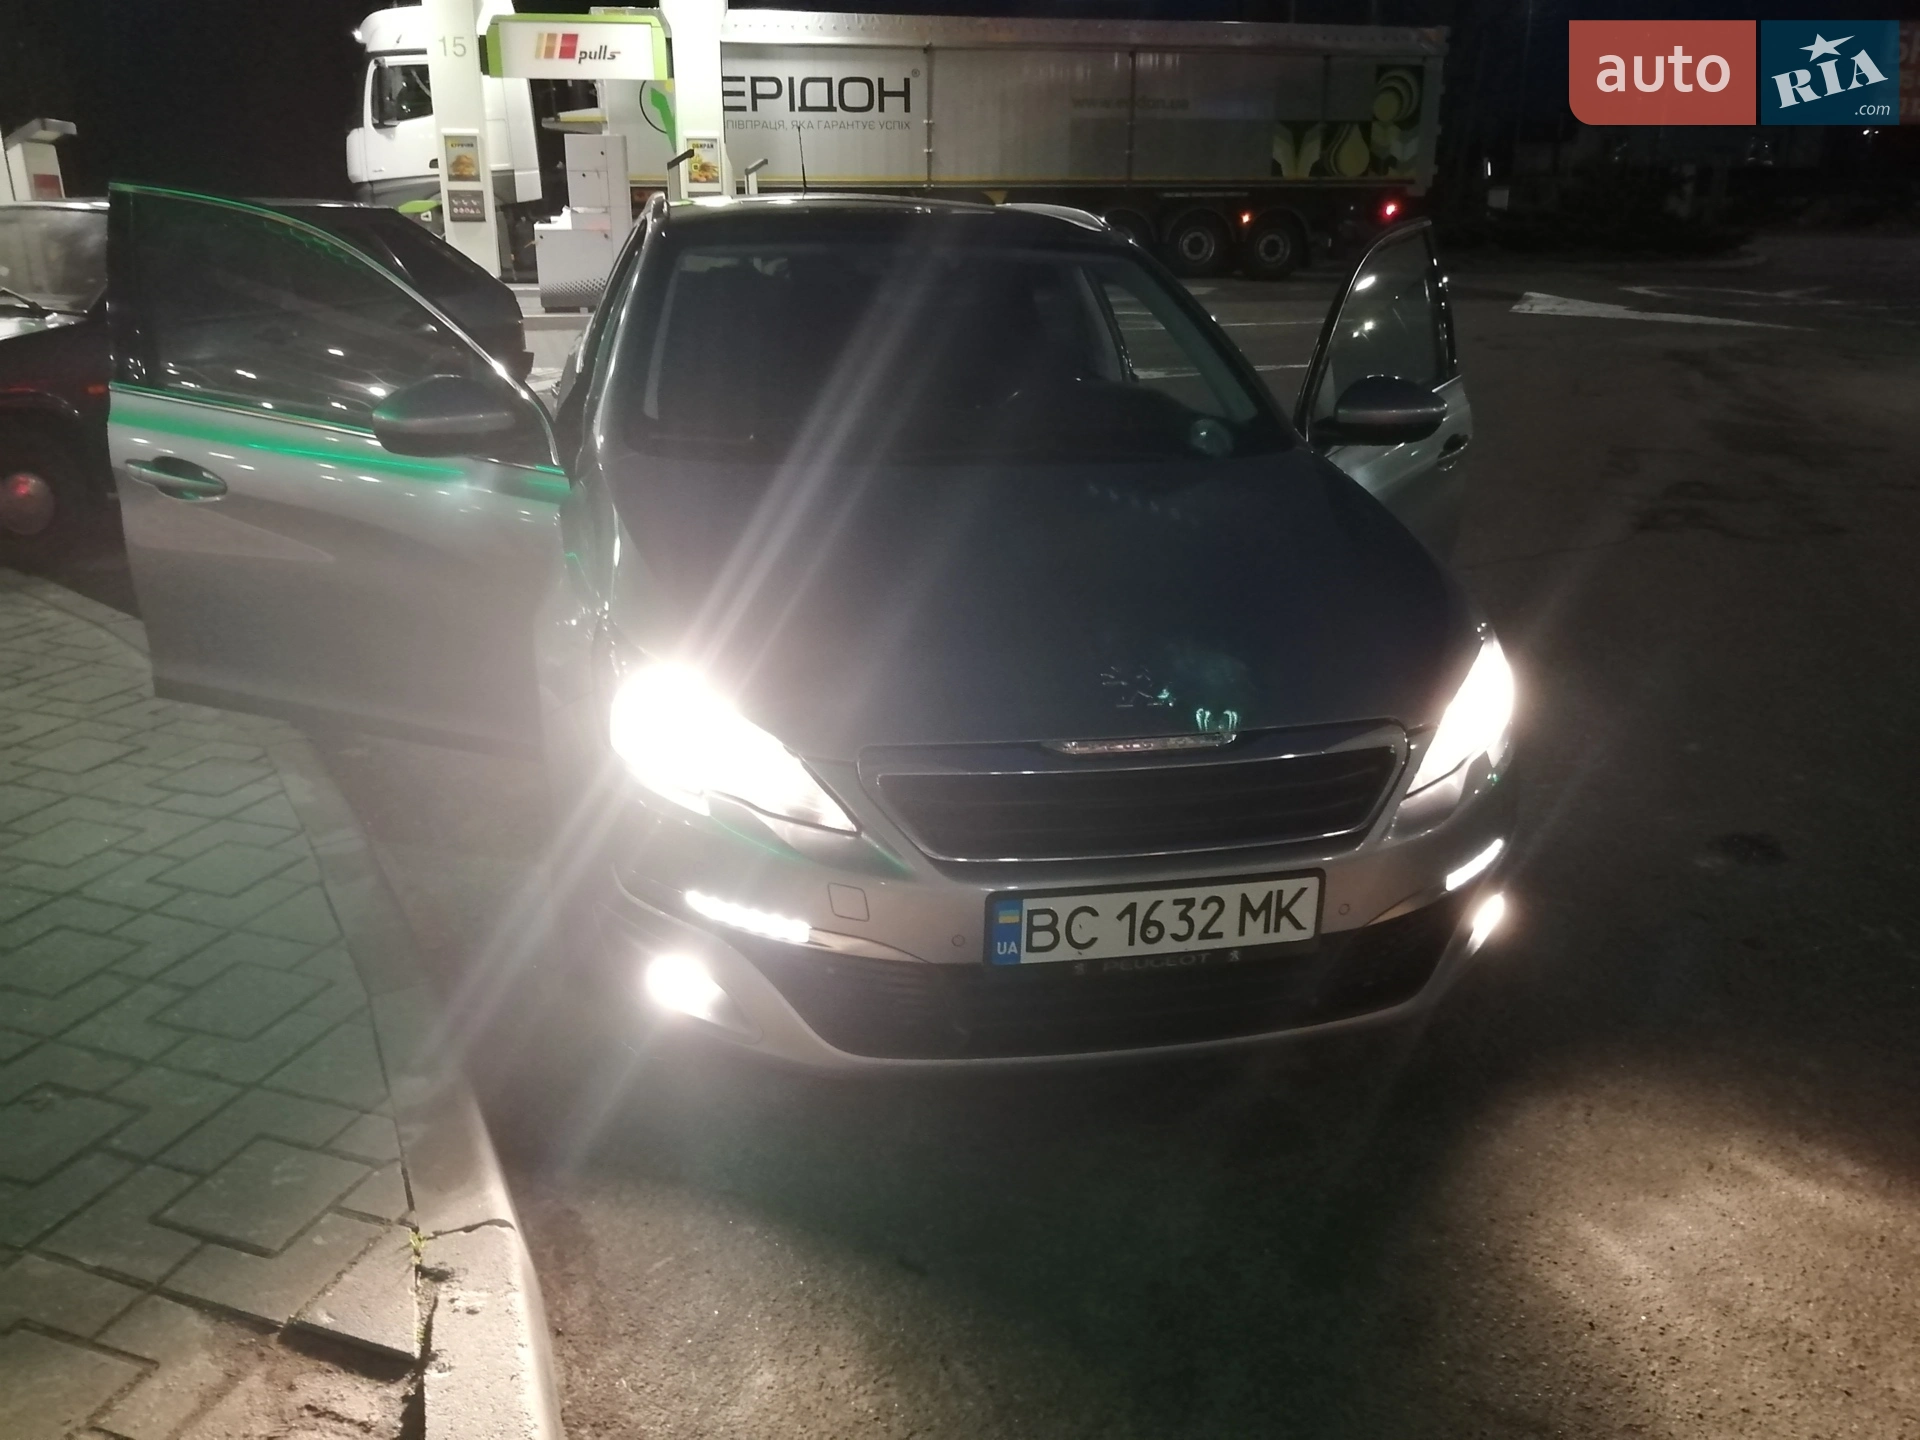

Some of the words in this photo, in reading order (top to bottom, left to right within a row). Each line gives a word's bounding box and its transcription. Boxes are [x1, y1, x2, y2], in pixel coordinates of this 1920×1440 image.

[438, 36, 467, 57] 15
[578, 45, 621, 64] pulls
[725, 119, 788, 131] ПІВПРАЦЯ,
[791, 119, 815, 130] ЯКА
[817, 120, 875, 130] ГАРАНТУЄ
[879, 120, 911, 130] УСПІХ
[1025, 905, 1099, 953] BC
[1116, 896, 1226, 947] 1632
[1238, 887, 1308, 936] MK
[997, 941, 1018, 955] UA
